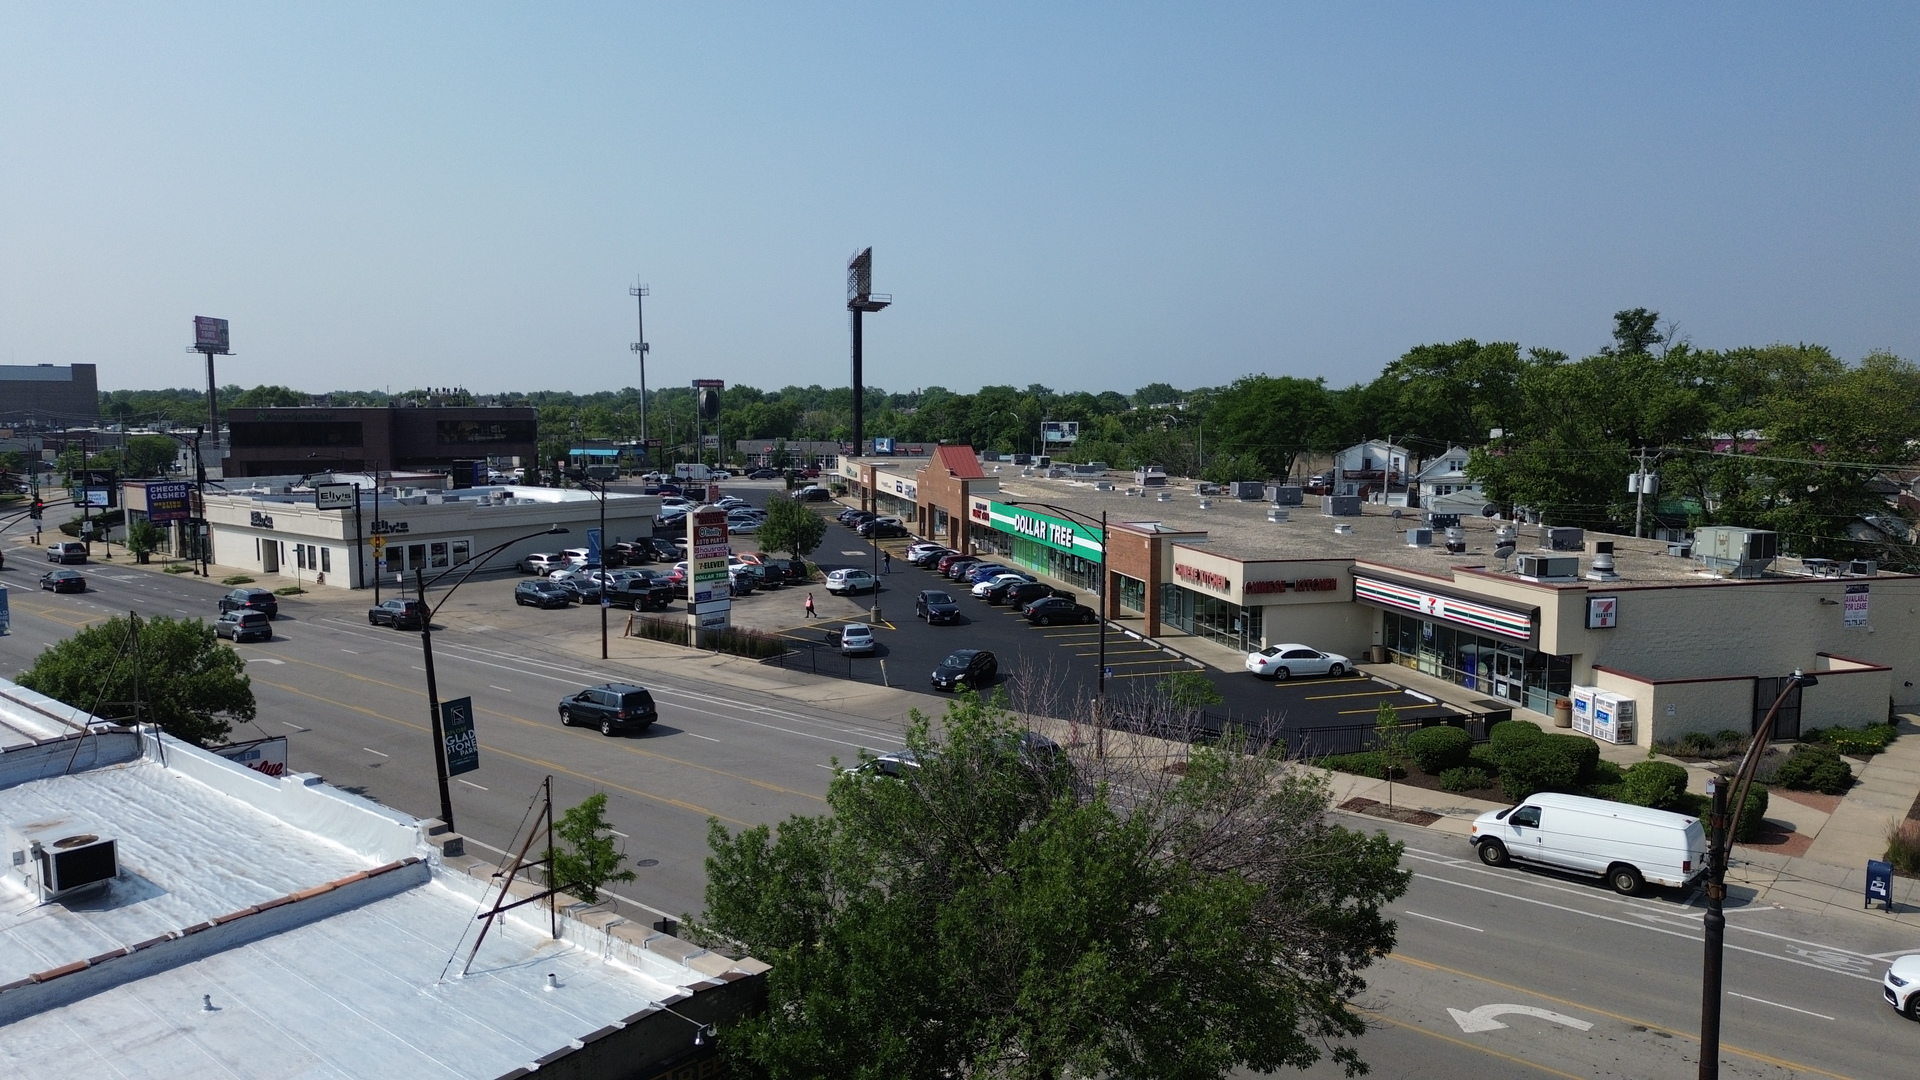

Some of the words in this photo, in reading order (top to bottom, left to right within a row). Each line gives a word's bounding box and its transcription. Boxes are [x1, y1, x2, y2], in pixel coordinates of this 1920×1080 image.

[150, 485, 186, 493] CHECKS
[150, 492, 187, 500] CASHED
[320, 491, 351, 501] Elly's
[371, 519, 409, 533] Elly's
[1014, 513, 1048, 541] DOLLAR
[1049, 523, 1074, 548] TREE
[710, 536, 726, 544] PARTS
[695, 573, 715, 581] DOLLAR
[1174, 562, 1199, 580] CHINESE
[1199, 569, 1227, 590] KITCHEN
[1244, 580, 1287, 595] CHINESE
[1294, 578, 1338, 593] KITCHEN
[1854, 602, 1867, 610] LEASE
[1596, 601, 1613, 625] 7
[445, 730, 476, 745] GLAD
[447, 739, 477, 755] STONE
[460, 747, 479, 757] PARK
